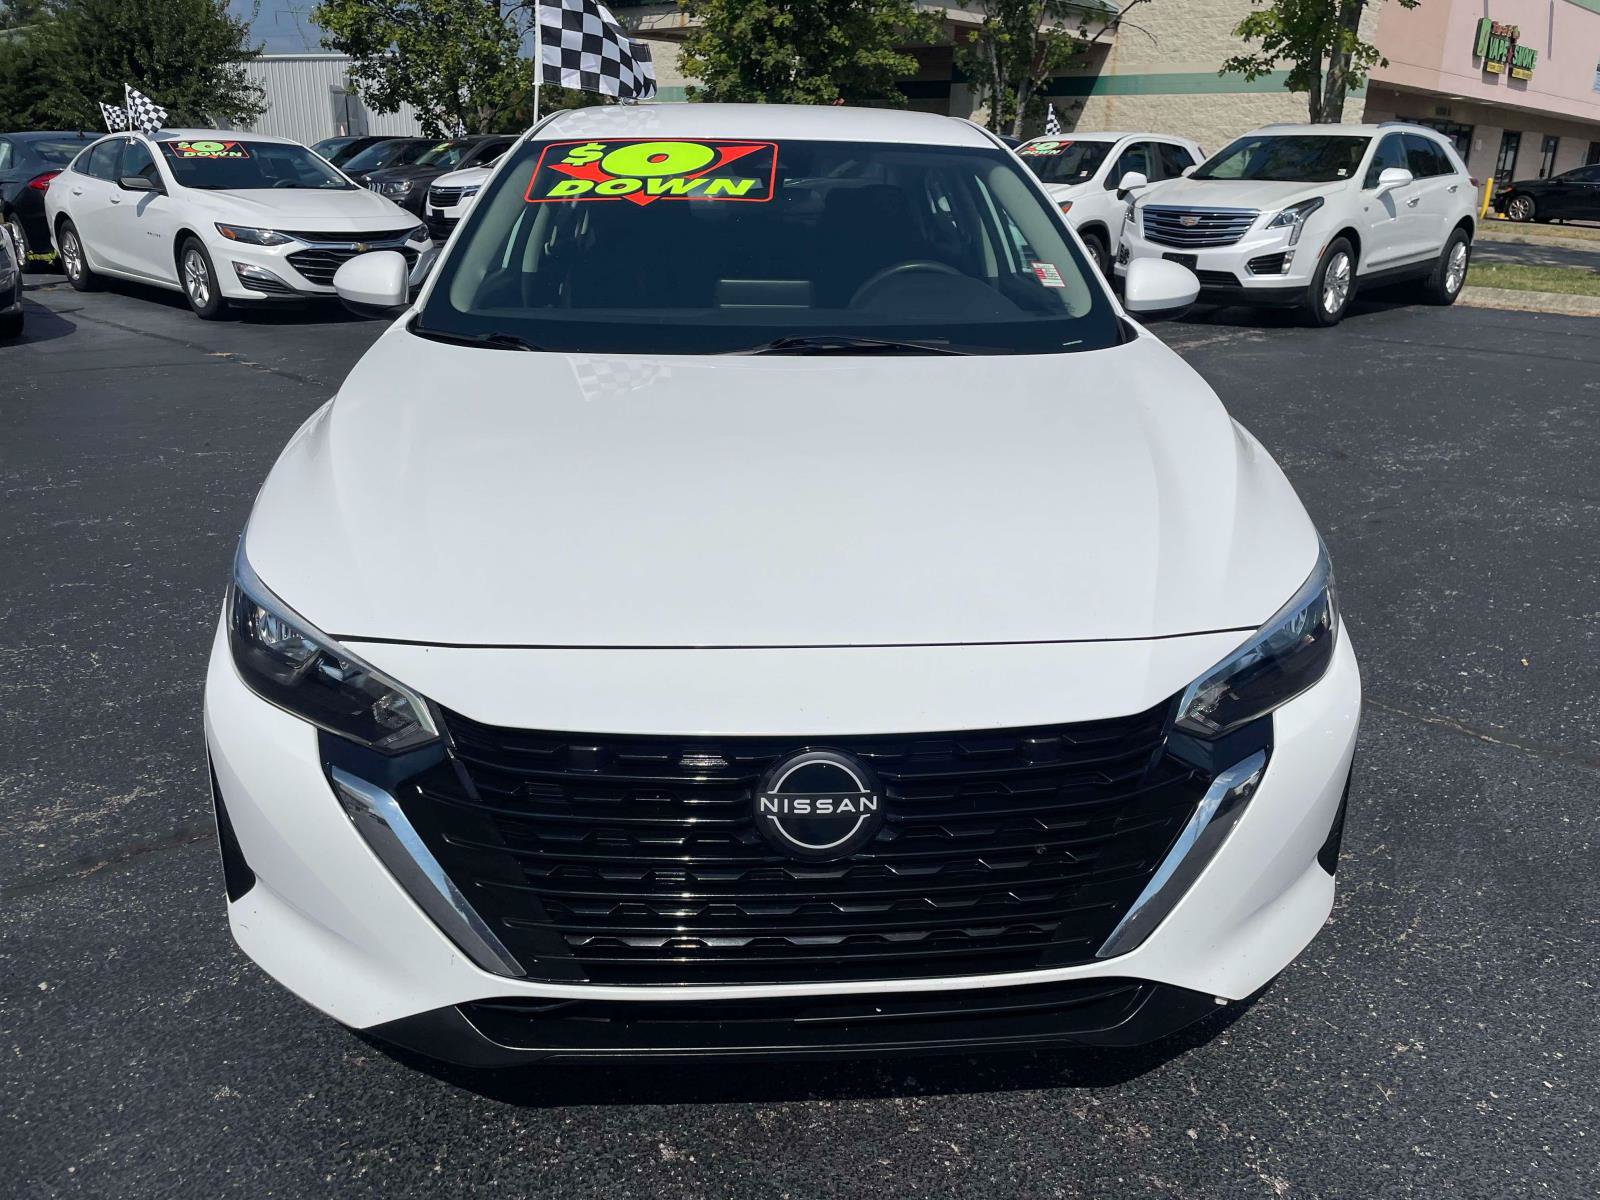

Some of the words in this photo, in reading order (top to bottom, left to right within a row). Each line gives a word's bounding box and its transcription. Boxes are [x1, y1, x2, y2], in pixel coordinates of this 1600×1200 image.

[1488, 37, 1510, 63] VAPE
[1513, 45, 1538, 69] SMOKE
[546, 178, 755, 196] DOWN
[760, 795, 877, 813] NISSAN
